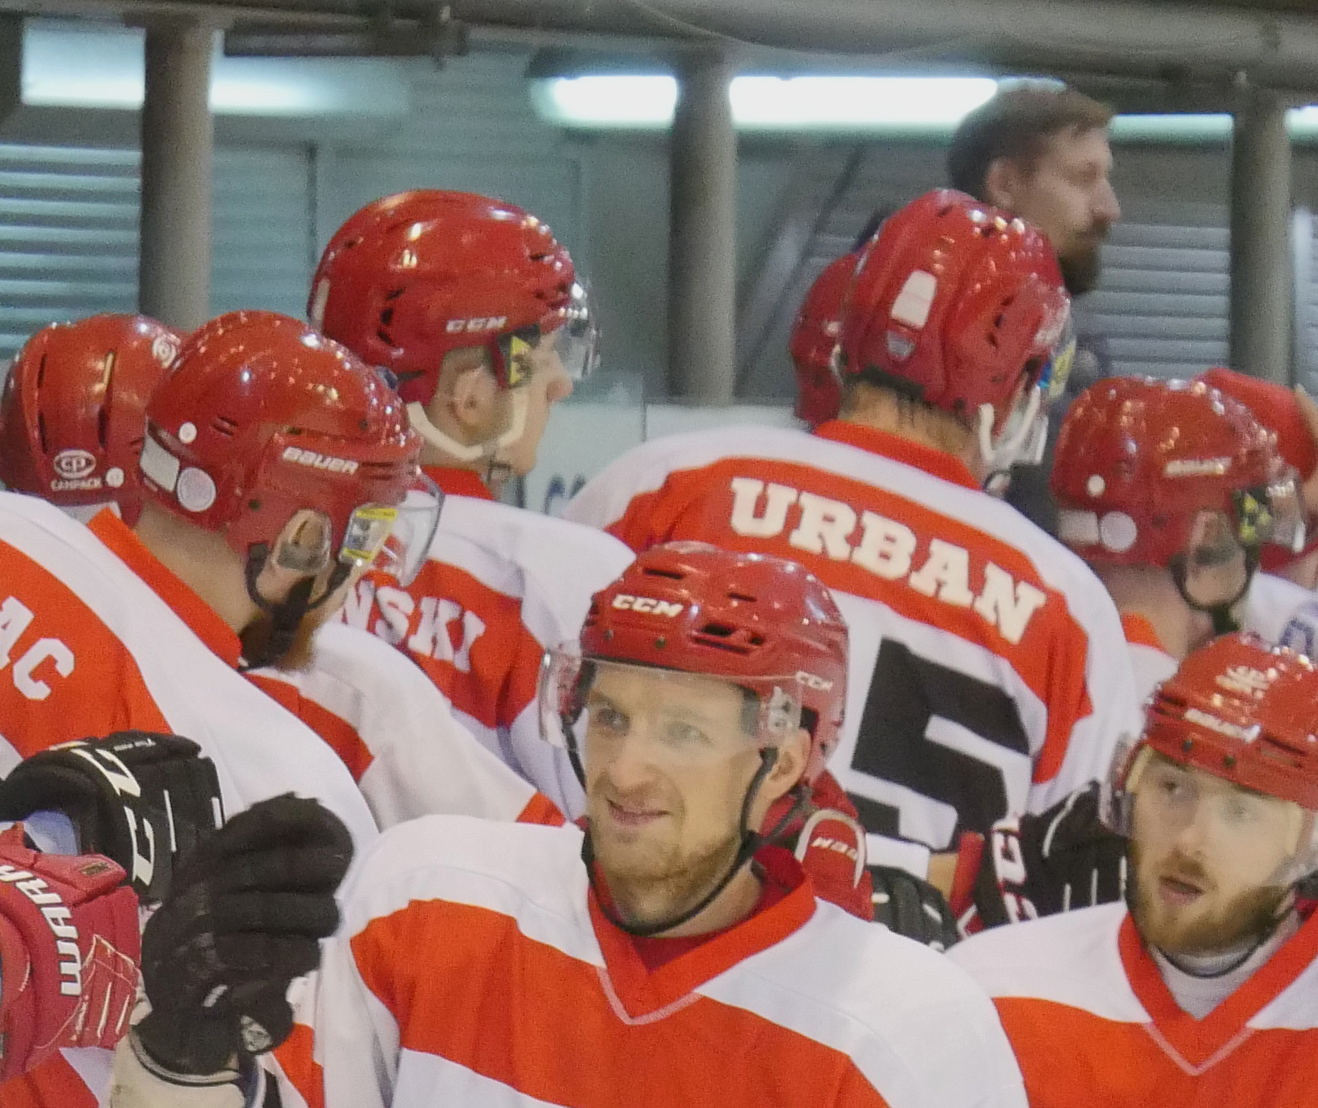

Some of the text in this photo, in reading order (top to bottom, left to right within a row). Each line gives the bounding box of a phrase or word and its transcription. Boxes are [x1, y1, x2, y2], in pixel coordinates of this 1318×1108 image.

[282, 446, 360, 475] BAUER
[730, 476, 1048, 645] URBAN
[332, 579, 487, 674] NSKI
[611, 594, 685, 618] CCM
